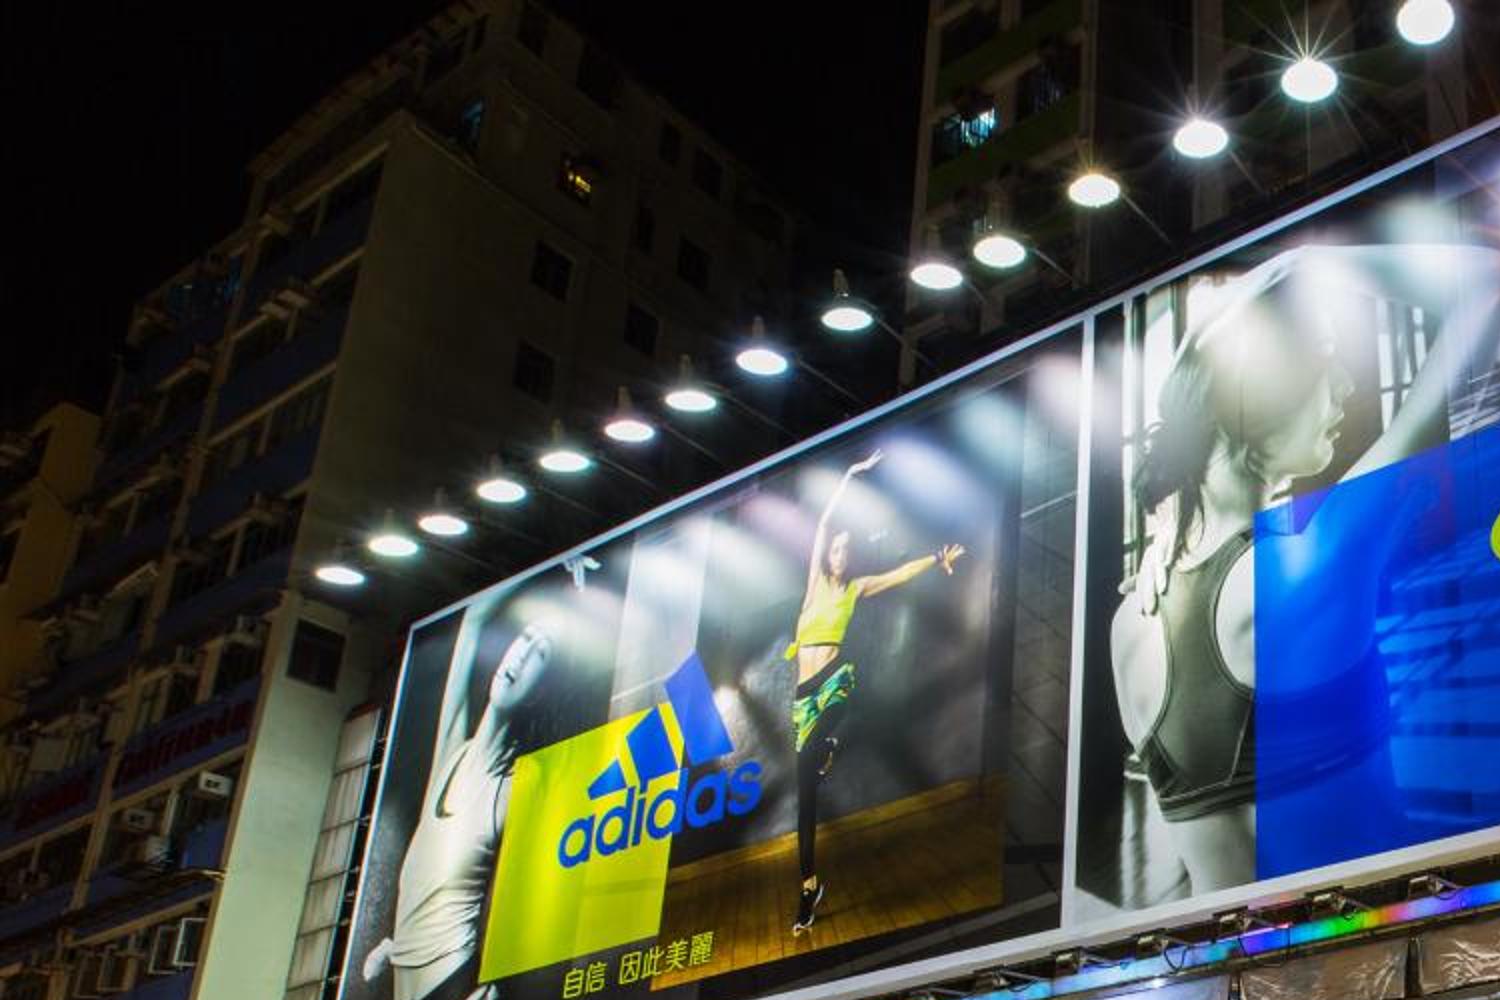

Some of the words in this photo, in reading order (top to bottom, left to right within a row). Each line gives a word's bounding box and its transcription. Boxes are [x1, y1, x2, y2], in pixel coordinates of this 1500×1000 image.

[558, 760, 764, 869] adidas
[563, 962, 609, 1000] 自信
[618, 931, 715, 985] 因此美麗
